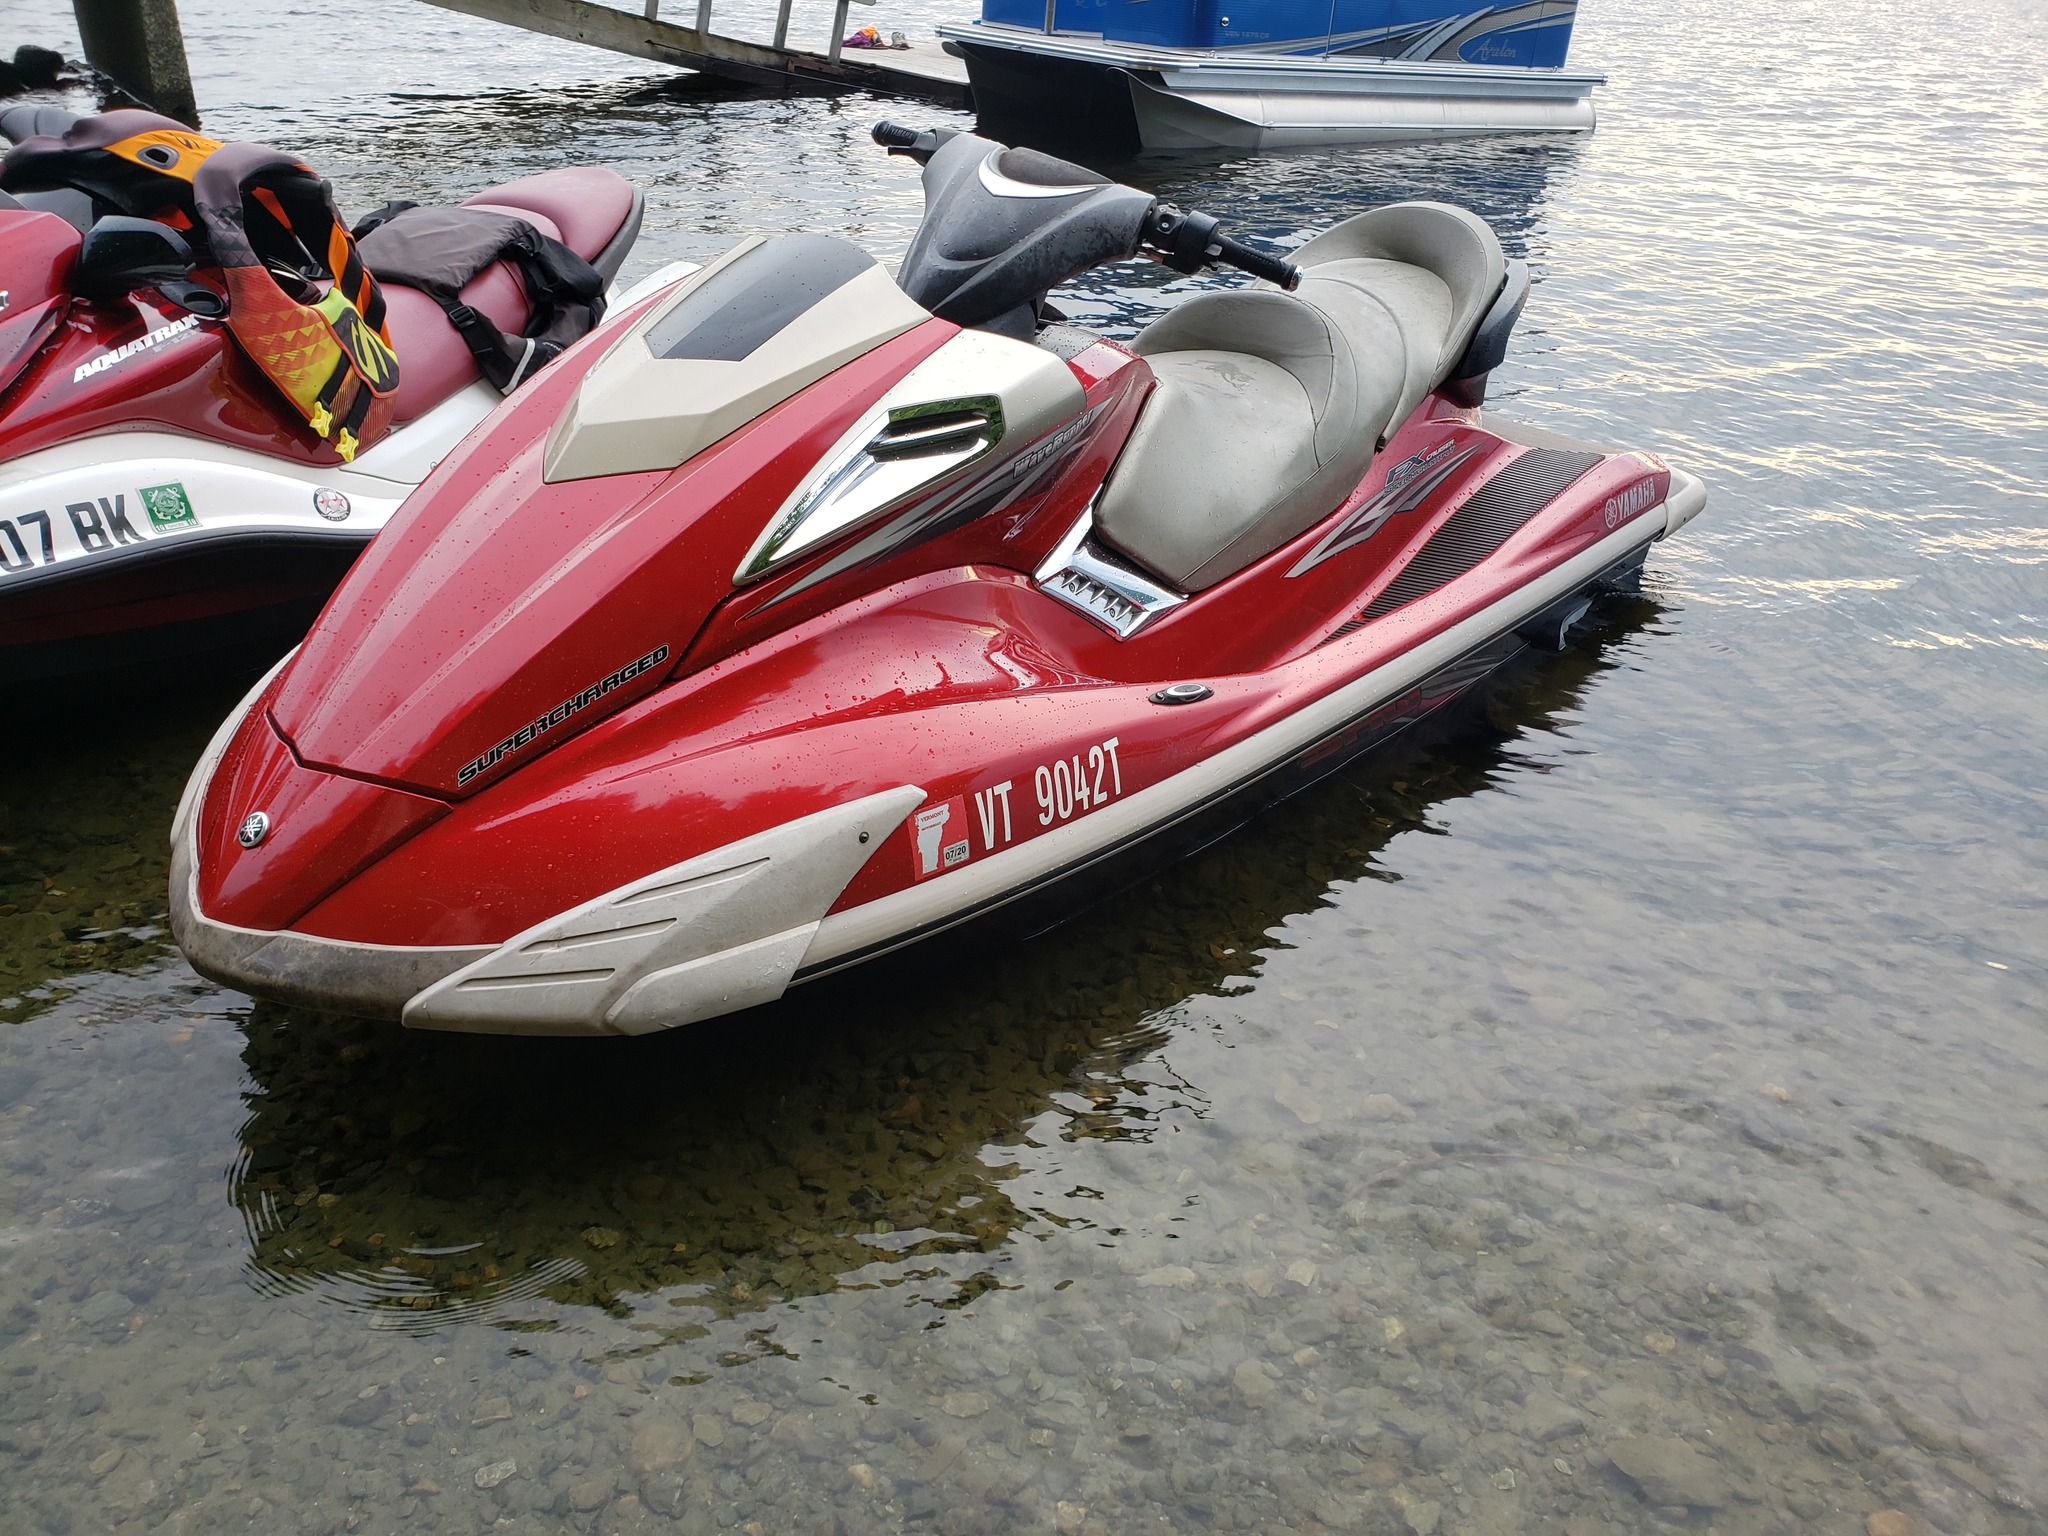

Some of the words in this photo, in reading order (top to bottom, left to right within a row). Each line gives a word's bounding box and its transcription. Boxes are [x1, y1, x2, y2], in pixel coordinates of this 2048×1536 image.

[1468, 38, 1517, 60] Avalon
[73, 313, 200, 384] AQUATRAX
[1013, 408, 1094, 479] WaveRunner
[1385, 445, 1430, 488] FX
[1426, 438, 1455, 461] CRUISER
[1617, 476, 1656, 521] YAMAHA
[0, 509, 56, 572] 07
[65, 494, 148, 553] BK
[456, 643, 670, 789] SUPERCHARGED
[920, 809, 944, 823] VERMONT
[974, 780, 1013, 851] VT
[1034, 736, 1121, 826] 9042T
[945, 845, 967, 860] 07/20
